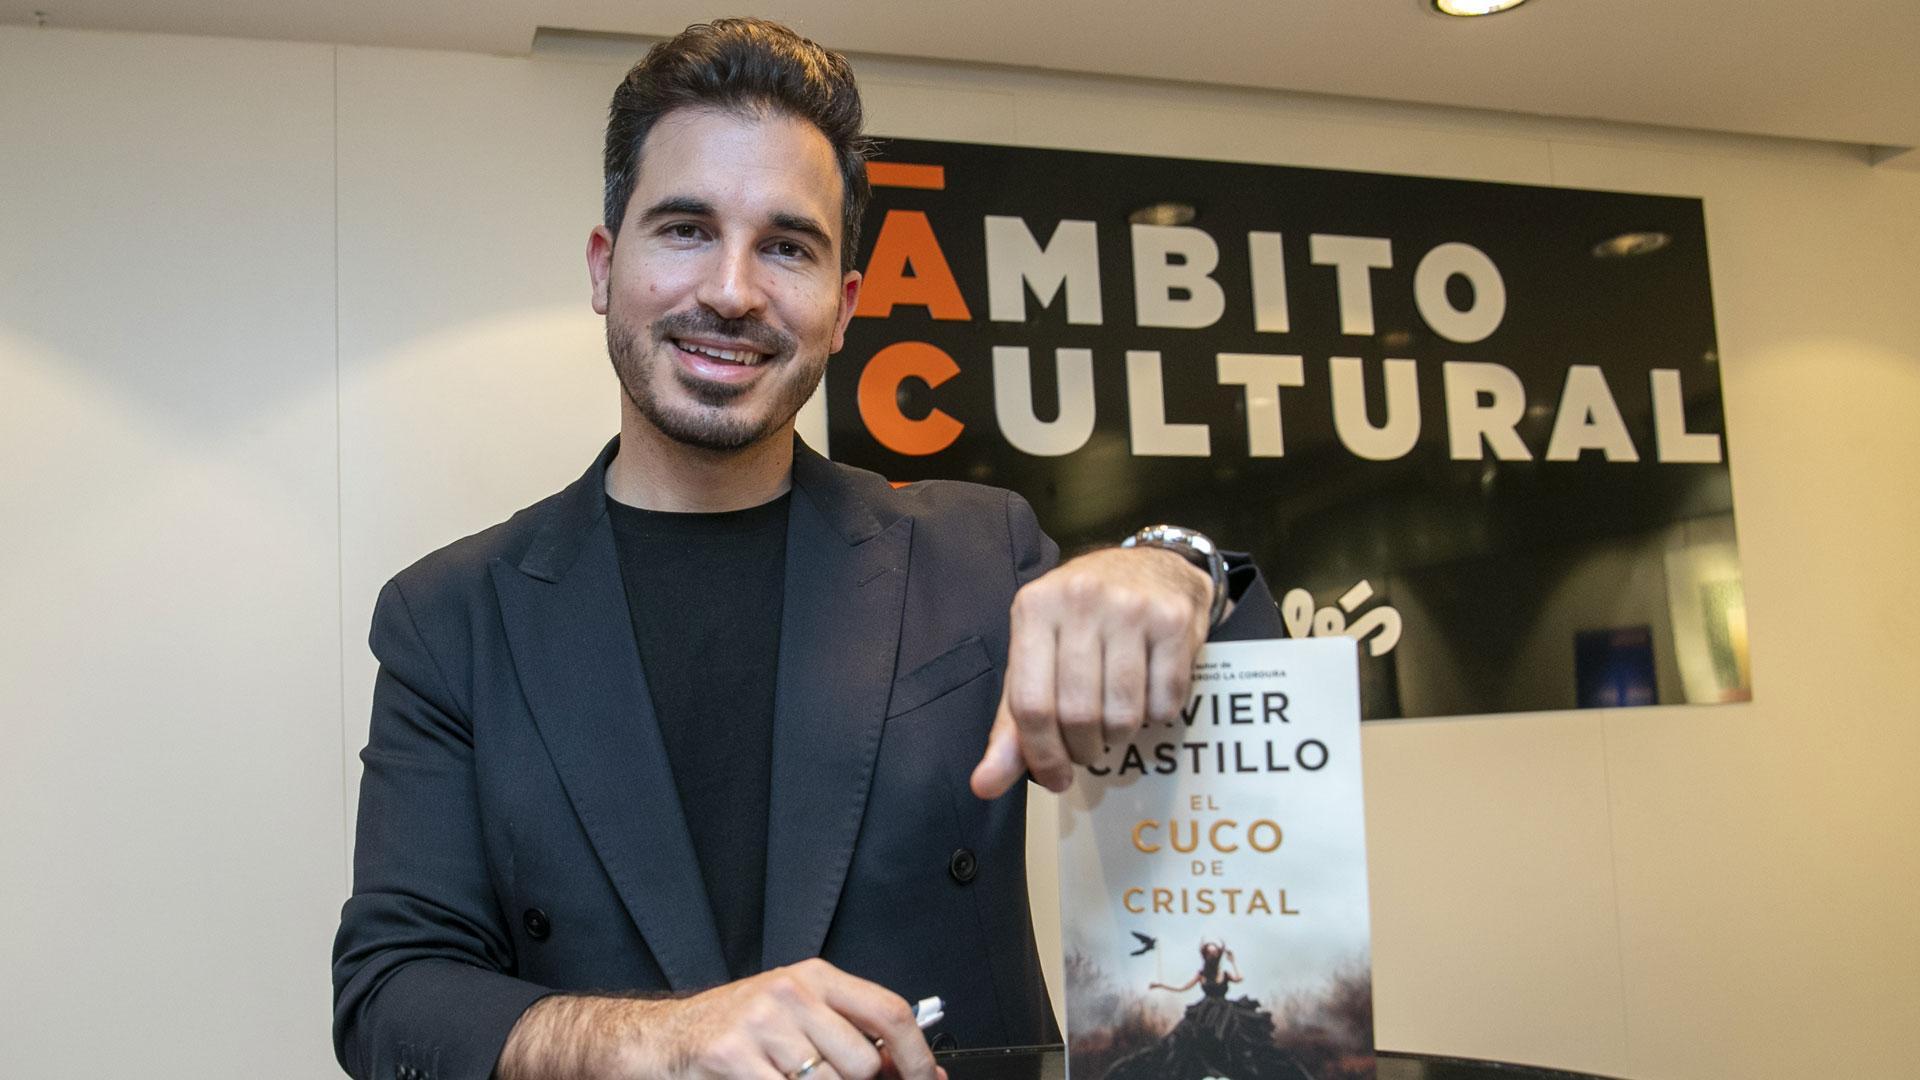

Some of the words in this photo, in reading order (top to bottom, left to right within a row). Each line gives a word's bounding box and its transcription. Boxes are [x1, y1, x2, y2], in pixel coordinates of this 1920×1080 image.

[857, 341, 1723, 465] CULTURAL
[1142, 692, 1290, 727] VIER
[1190, 795, 1219, 811] EL
[1131, 819, 1283, 853] CUCO
[1191, 860, 1224, 876] DE
[1122, 887, 1300, 915] CRISTAL
